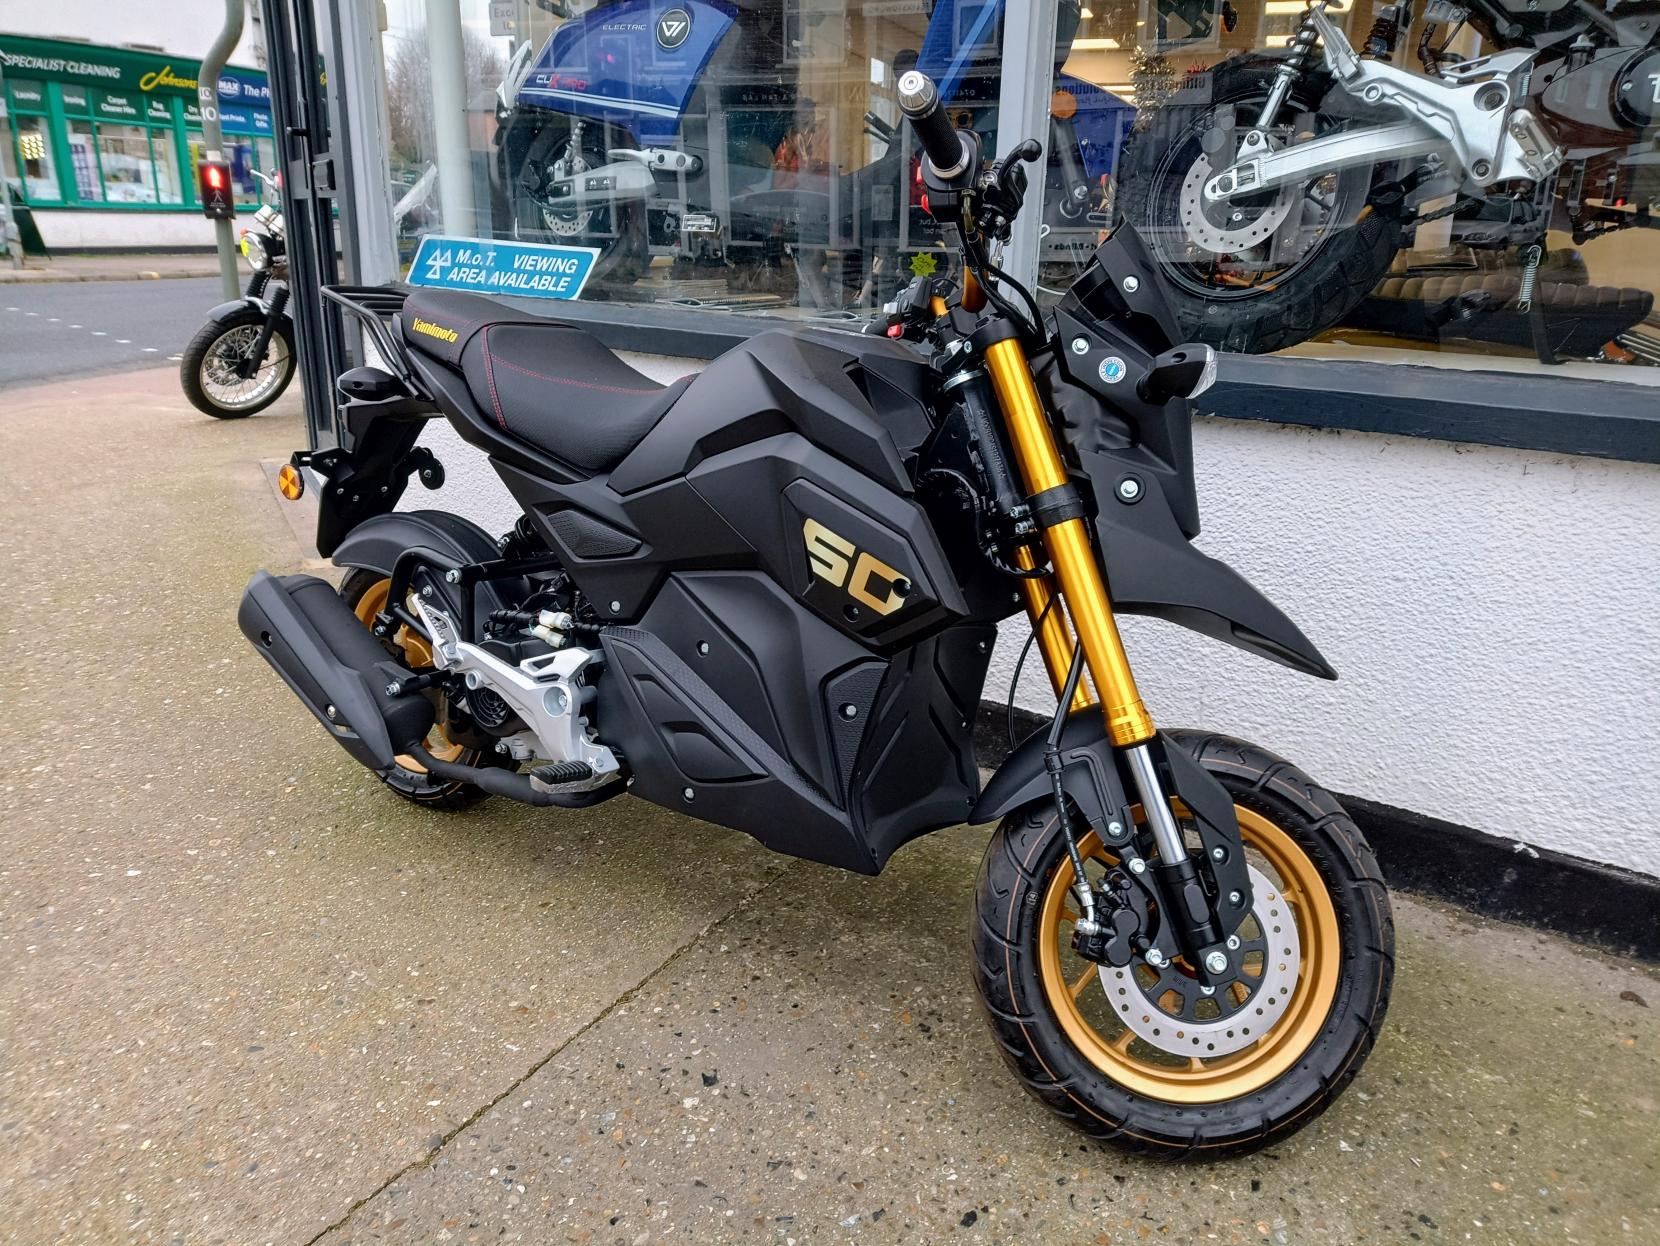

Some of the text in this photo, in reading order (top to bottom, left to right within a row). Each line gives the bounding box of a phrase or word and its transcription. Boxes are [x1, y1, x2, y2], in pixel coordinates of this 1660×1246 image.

[602, 23, 648, 31] ELECTRIC
[4, 54, 121, 79] SPECIALIST CLEANING
[243, 84, 260, 96] The
[200, 106, 216, 121] 10
[513, 254, 579, 274] VIEWING
[446, 267, 571, 292] AREA AVAILABLE
